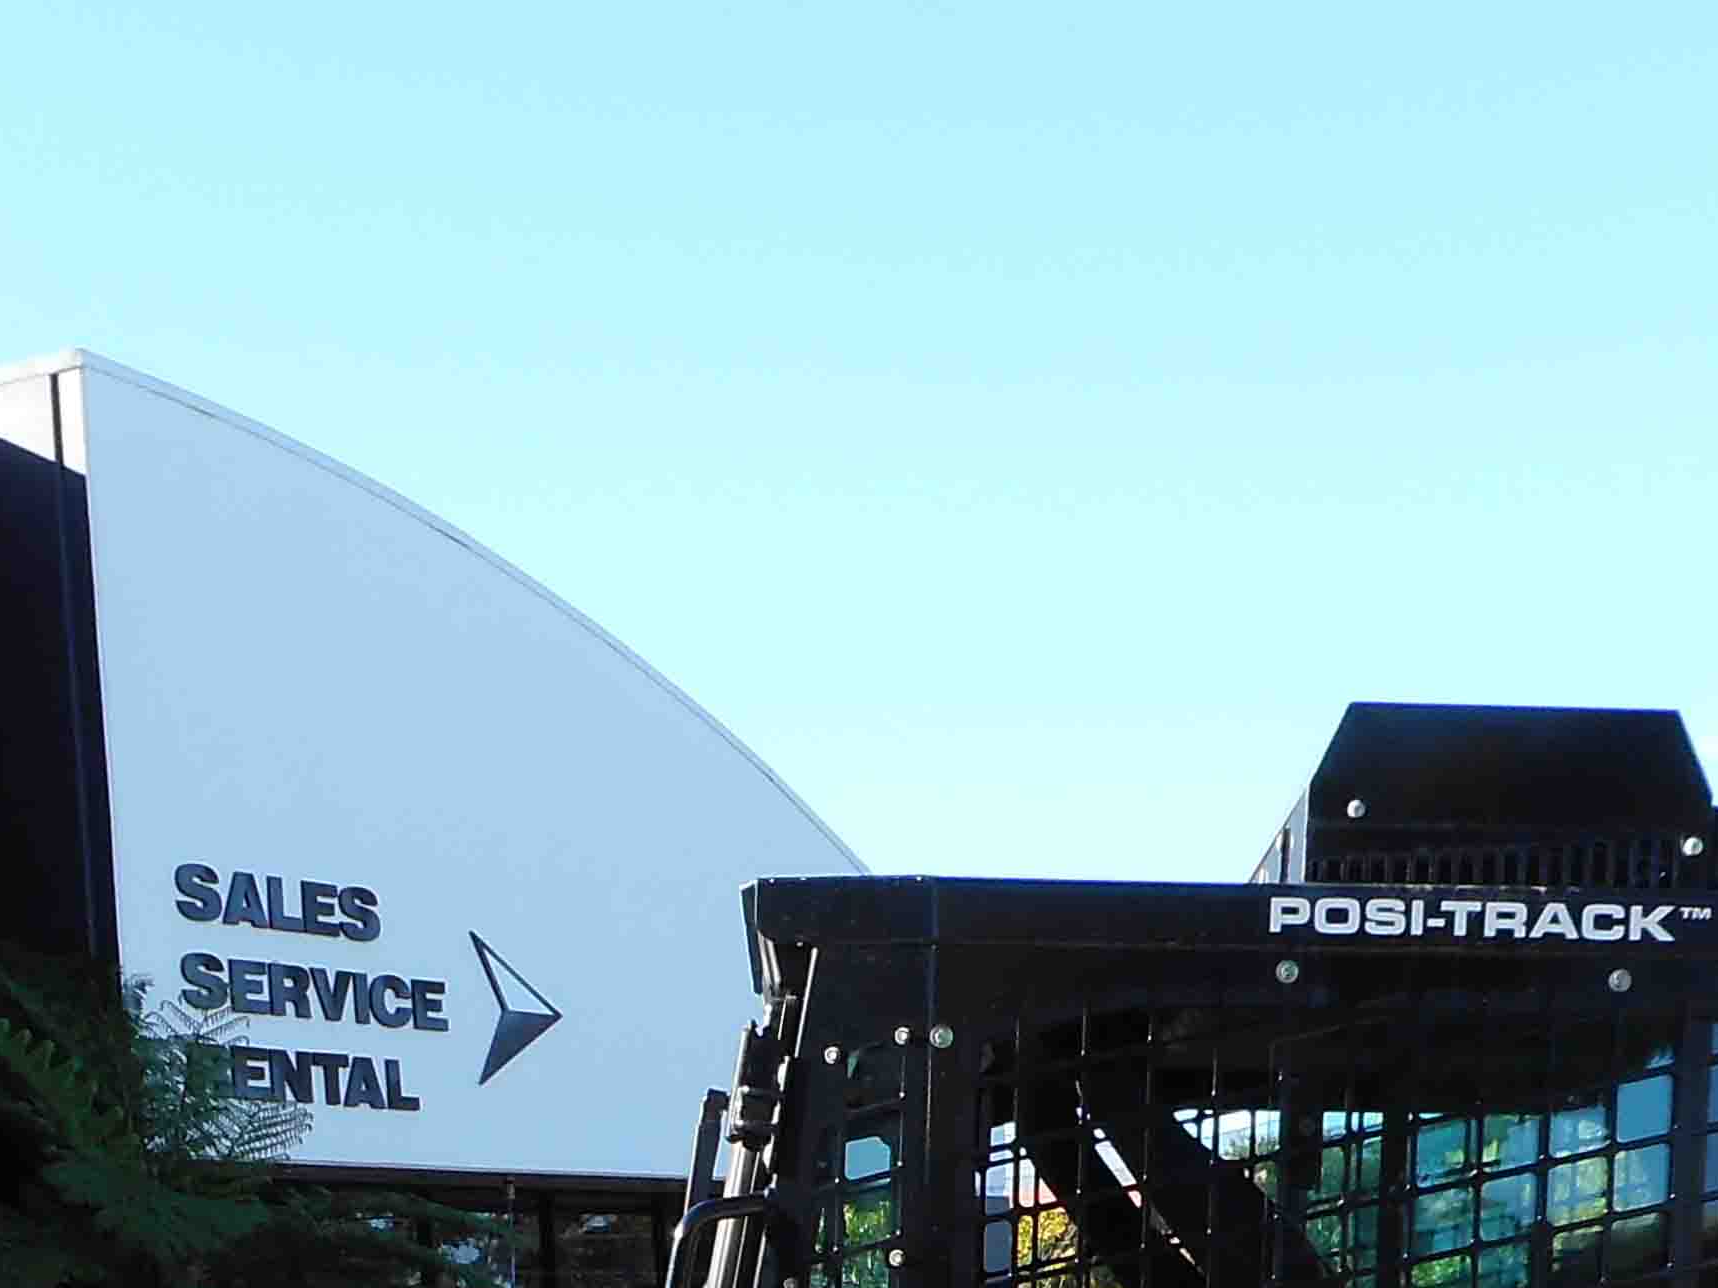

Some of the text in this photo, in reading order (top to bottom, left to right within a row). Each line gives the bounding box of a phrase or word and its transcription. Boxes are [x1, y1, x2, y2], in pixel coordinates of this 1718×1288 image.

[174, 862, 382, 942] SALES
[181, 952, 450, 1033] SERVICE
[188, 1040, 420, 1111] ENTAL
